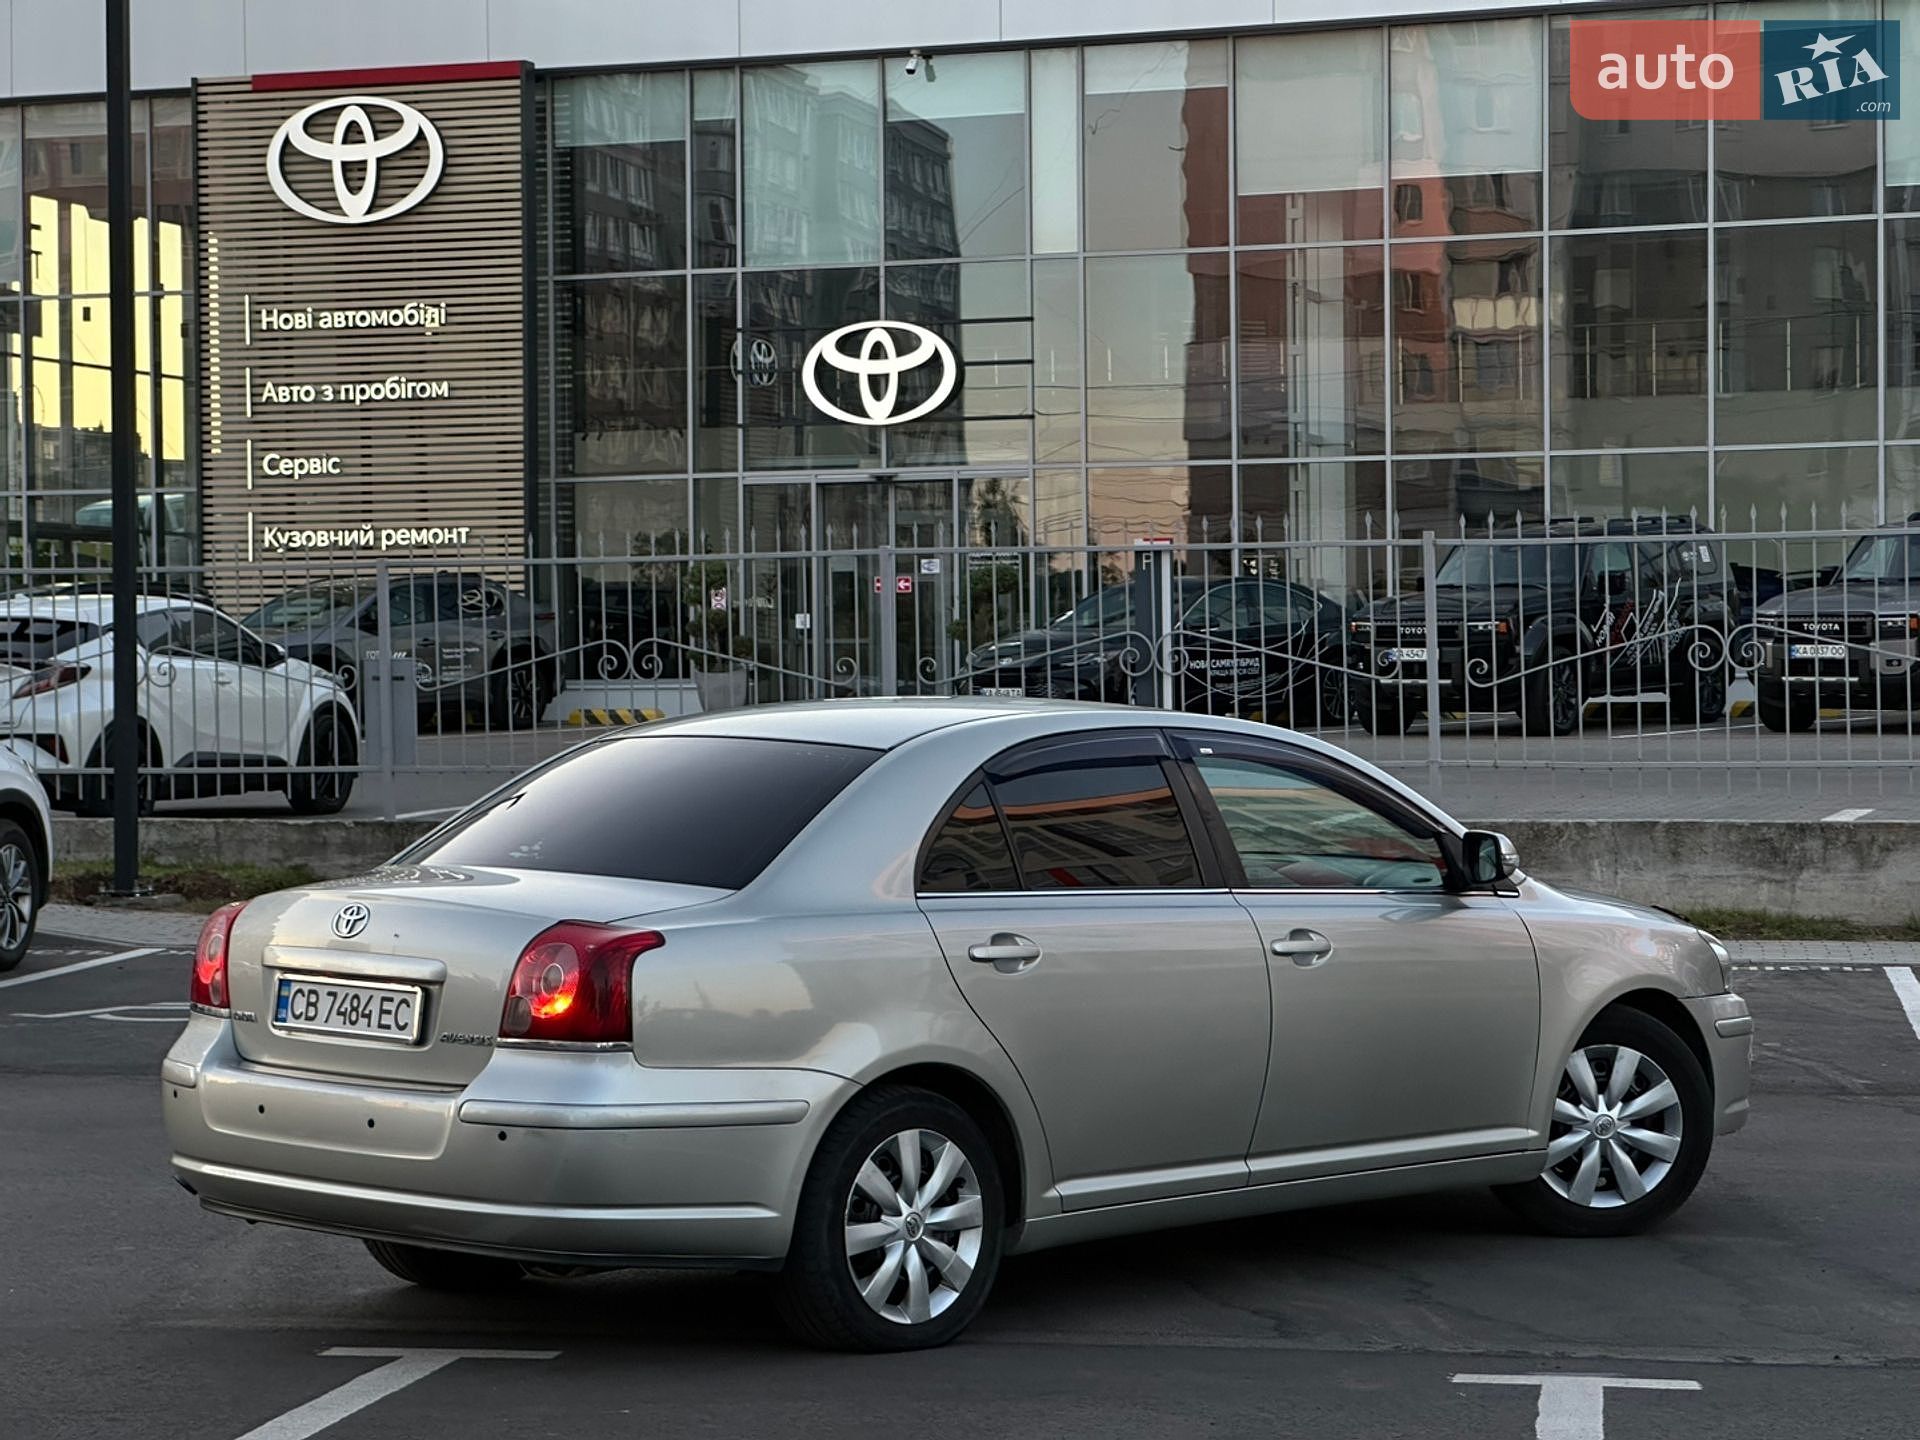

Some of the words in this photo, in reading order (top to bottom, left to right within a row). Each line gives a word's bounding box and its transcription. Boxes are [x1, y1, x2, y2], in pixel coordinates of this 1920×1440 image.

[261, 307, 313, 330] Нові
[262, 381, 316, 403] Авто
[321, 384, 334, 401] з
[340, 376, 449, 405] пробігом
[262, 453, 341, 480] Сервіс
[264, 523, 375, 553] Кузовний
[381, 526, 470, 551] ремонт
[1803, 623, 1840, 631] TOYOTA
[290, 988, 319, 1021] CB
[323, 991, 374, 1028] 7484
[377, 996, 411, 1031] EC
